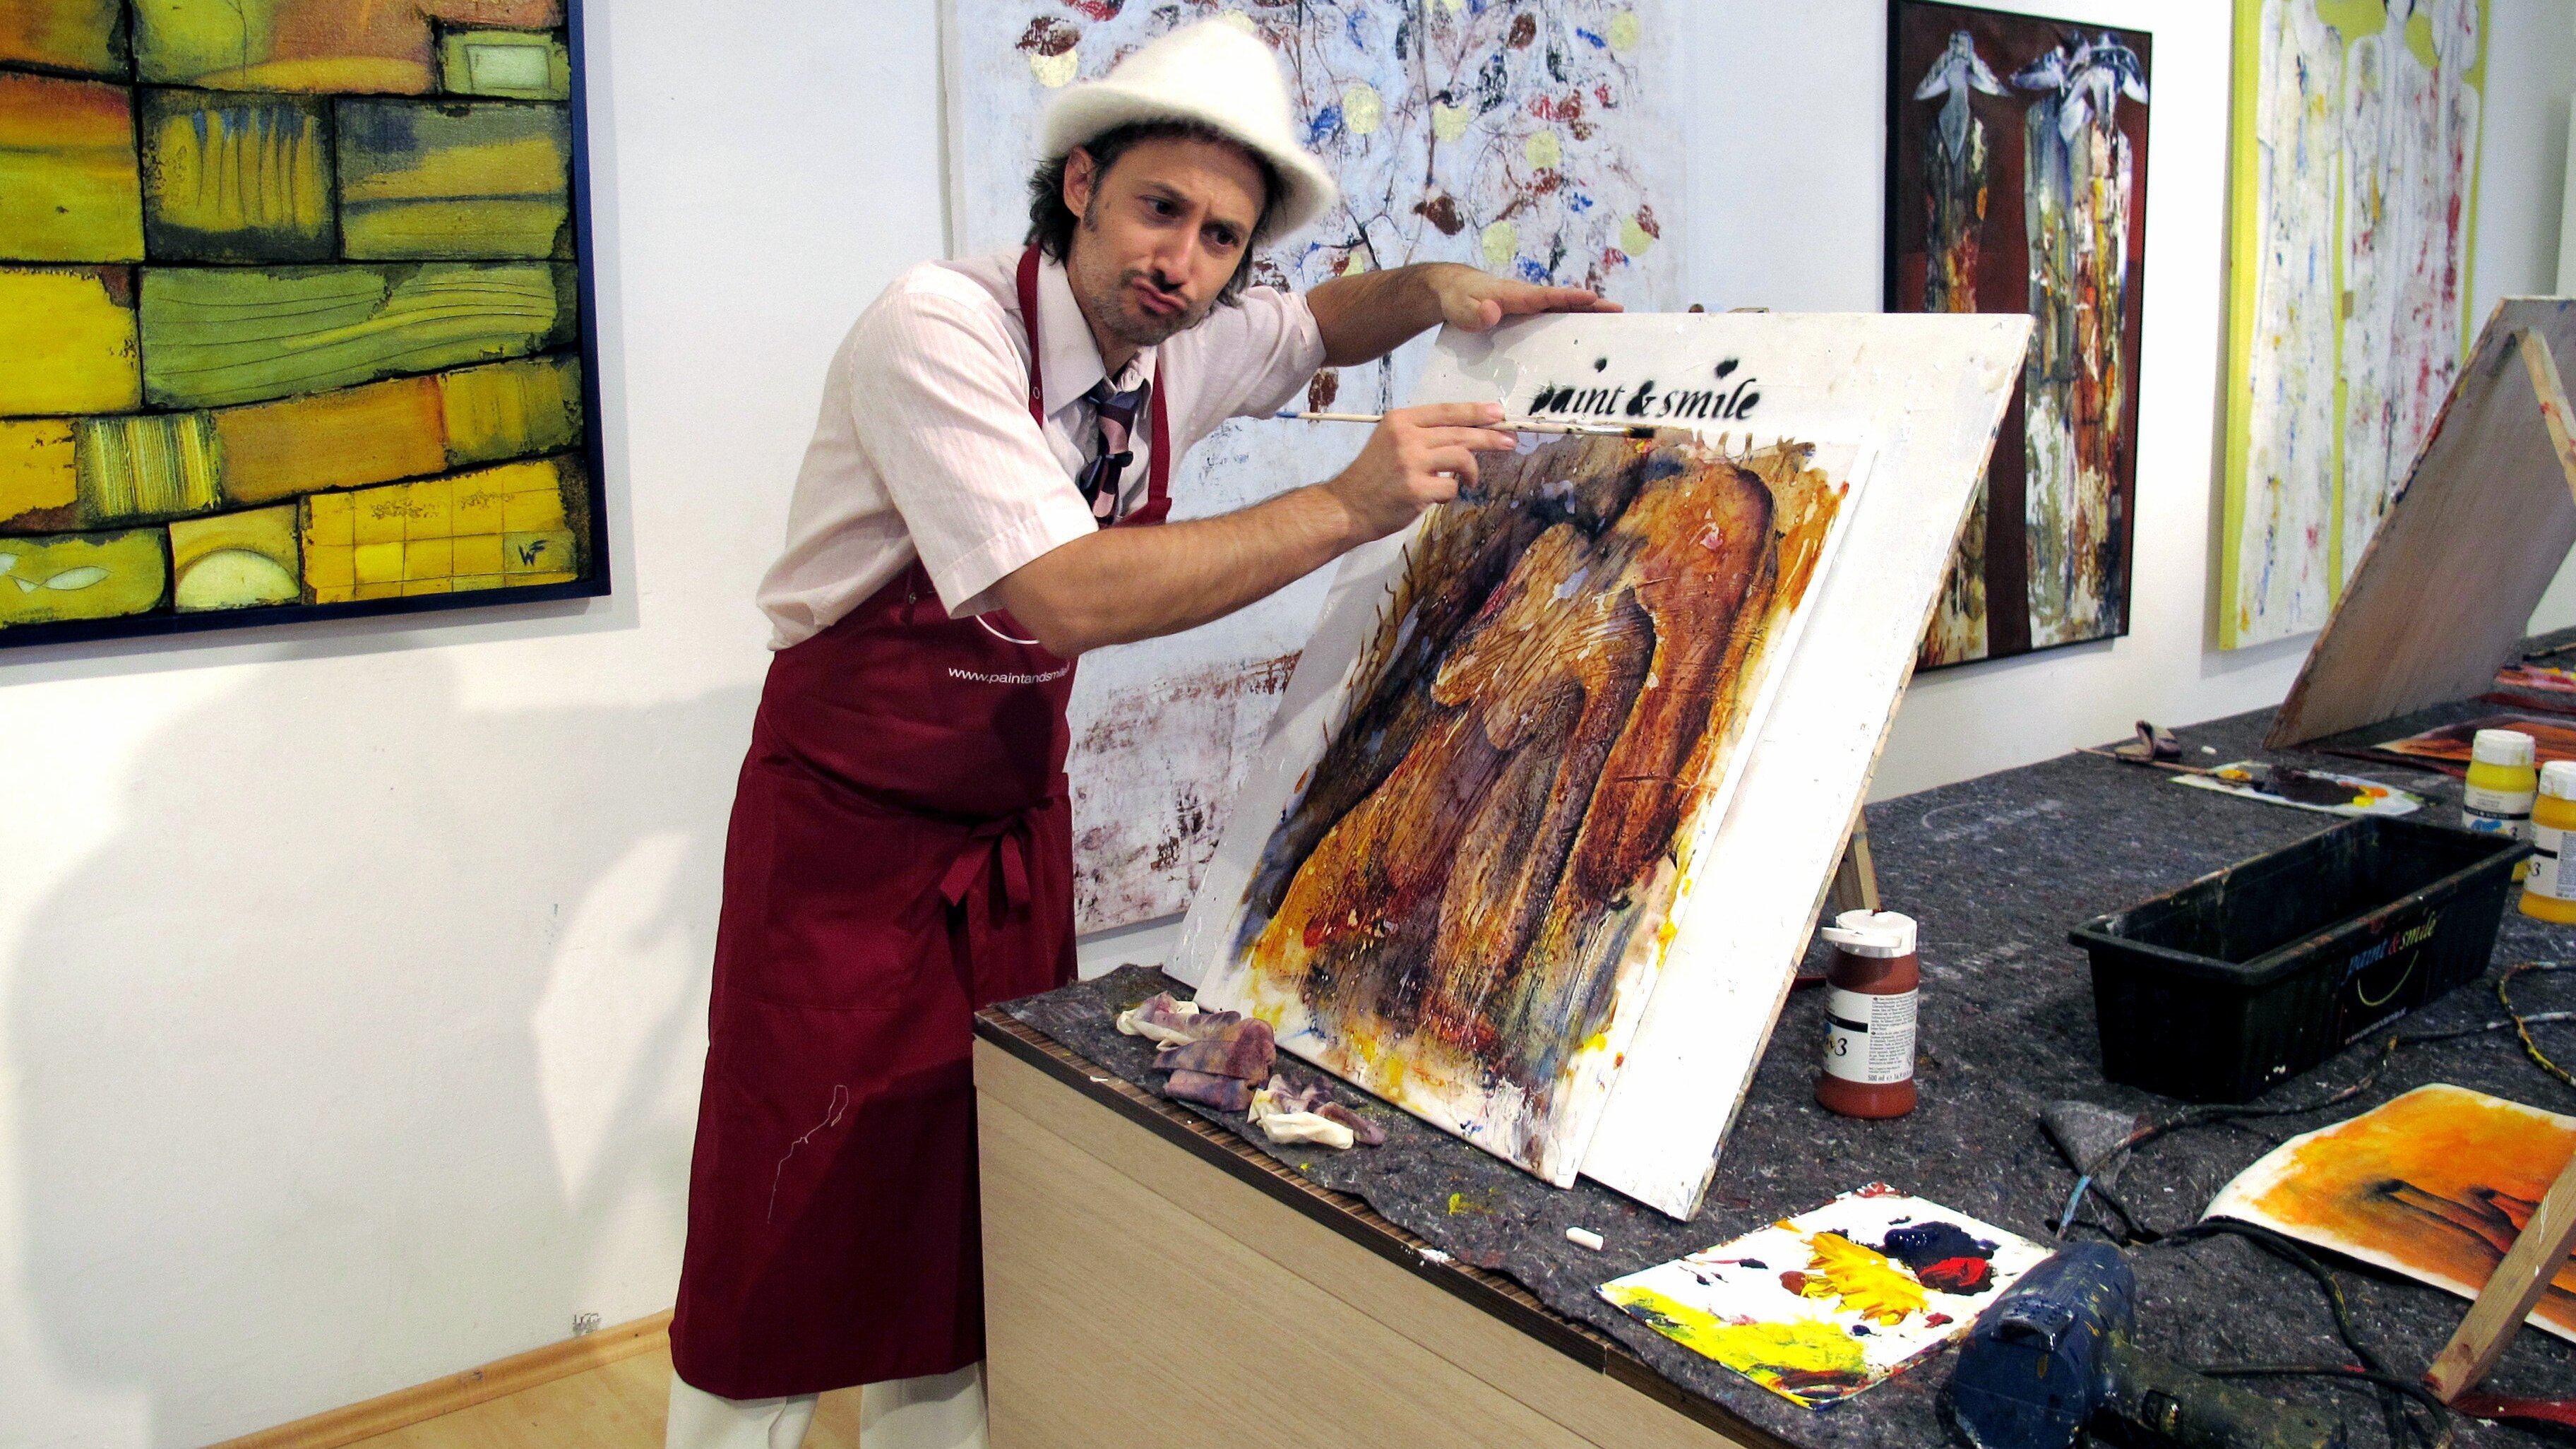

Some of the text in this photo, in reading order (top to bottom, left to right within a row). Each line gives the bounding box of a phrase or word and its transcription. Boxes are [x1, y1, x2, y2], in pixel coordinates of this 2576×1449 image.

[1626, 379, 1656, 417] &
[1656, 358, 1760, 420] smile
[2399, 909, 2436, 950] smile
[1834, 1037, 1848, 1056] 3
